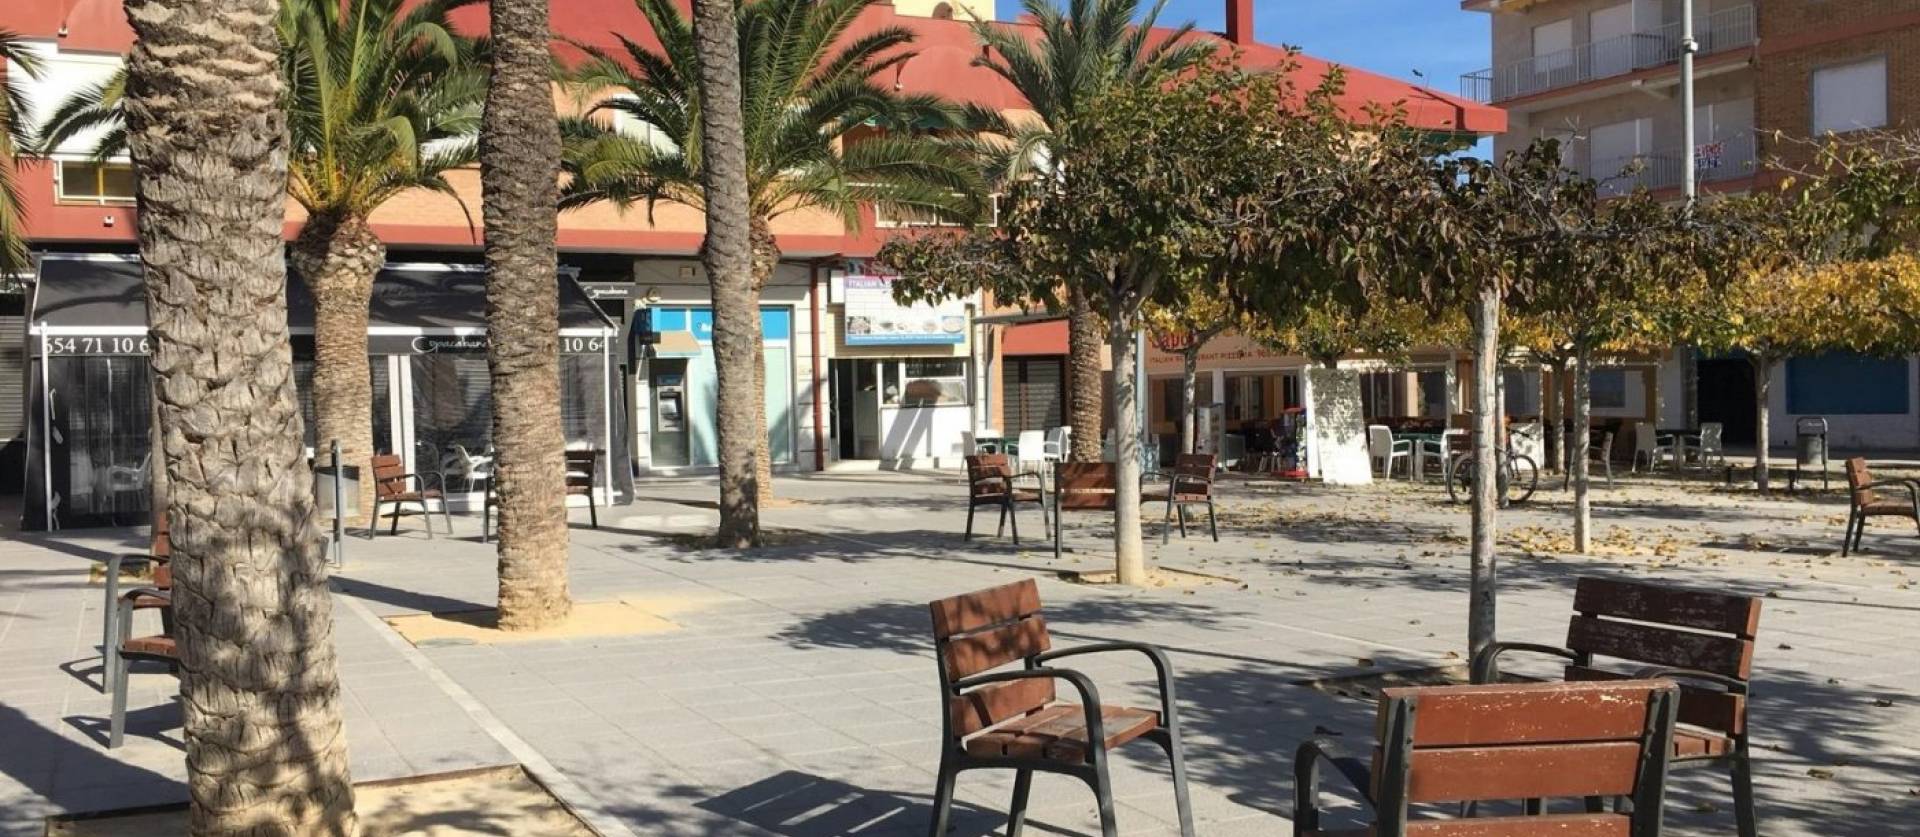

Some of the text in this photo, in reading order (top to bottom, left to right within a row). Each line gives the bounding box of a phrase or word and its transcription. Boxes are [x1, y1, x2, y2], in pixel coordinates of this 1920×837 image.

[81, 337, 103, 353] 71
[112, 337, 134, 353] 10
[139, 337, 150, 353] 6
[411, 336, 487, 353] Copacaban
[564, 337, 584, 353] 10
